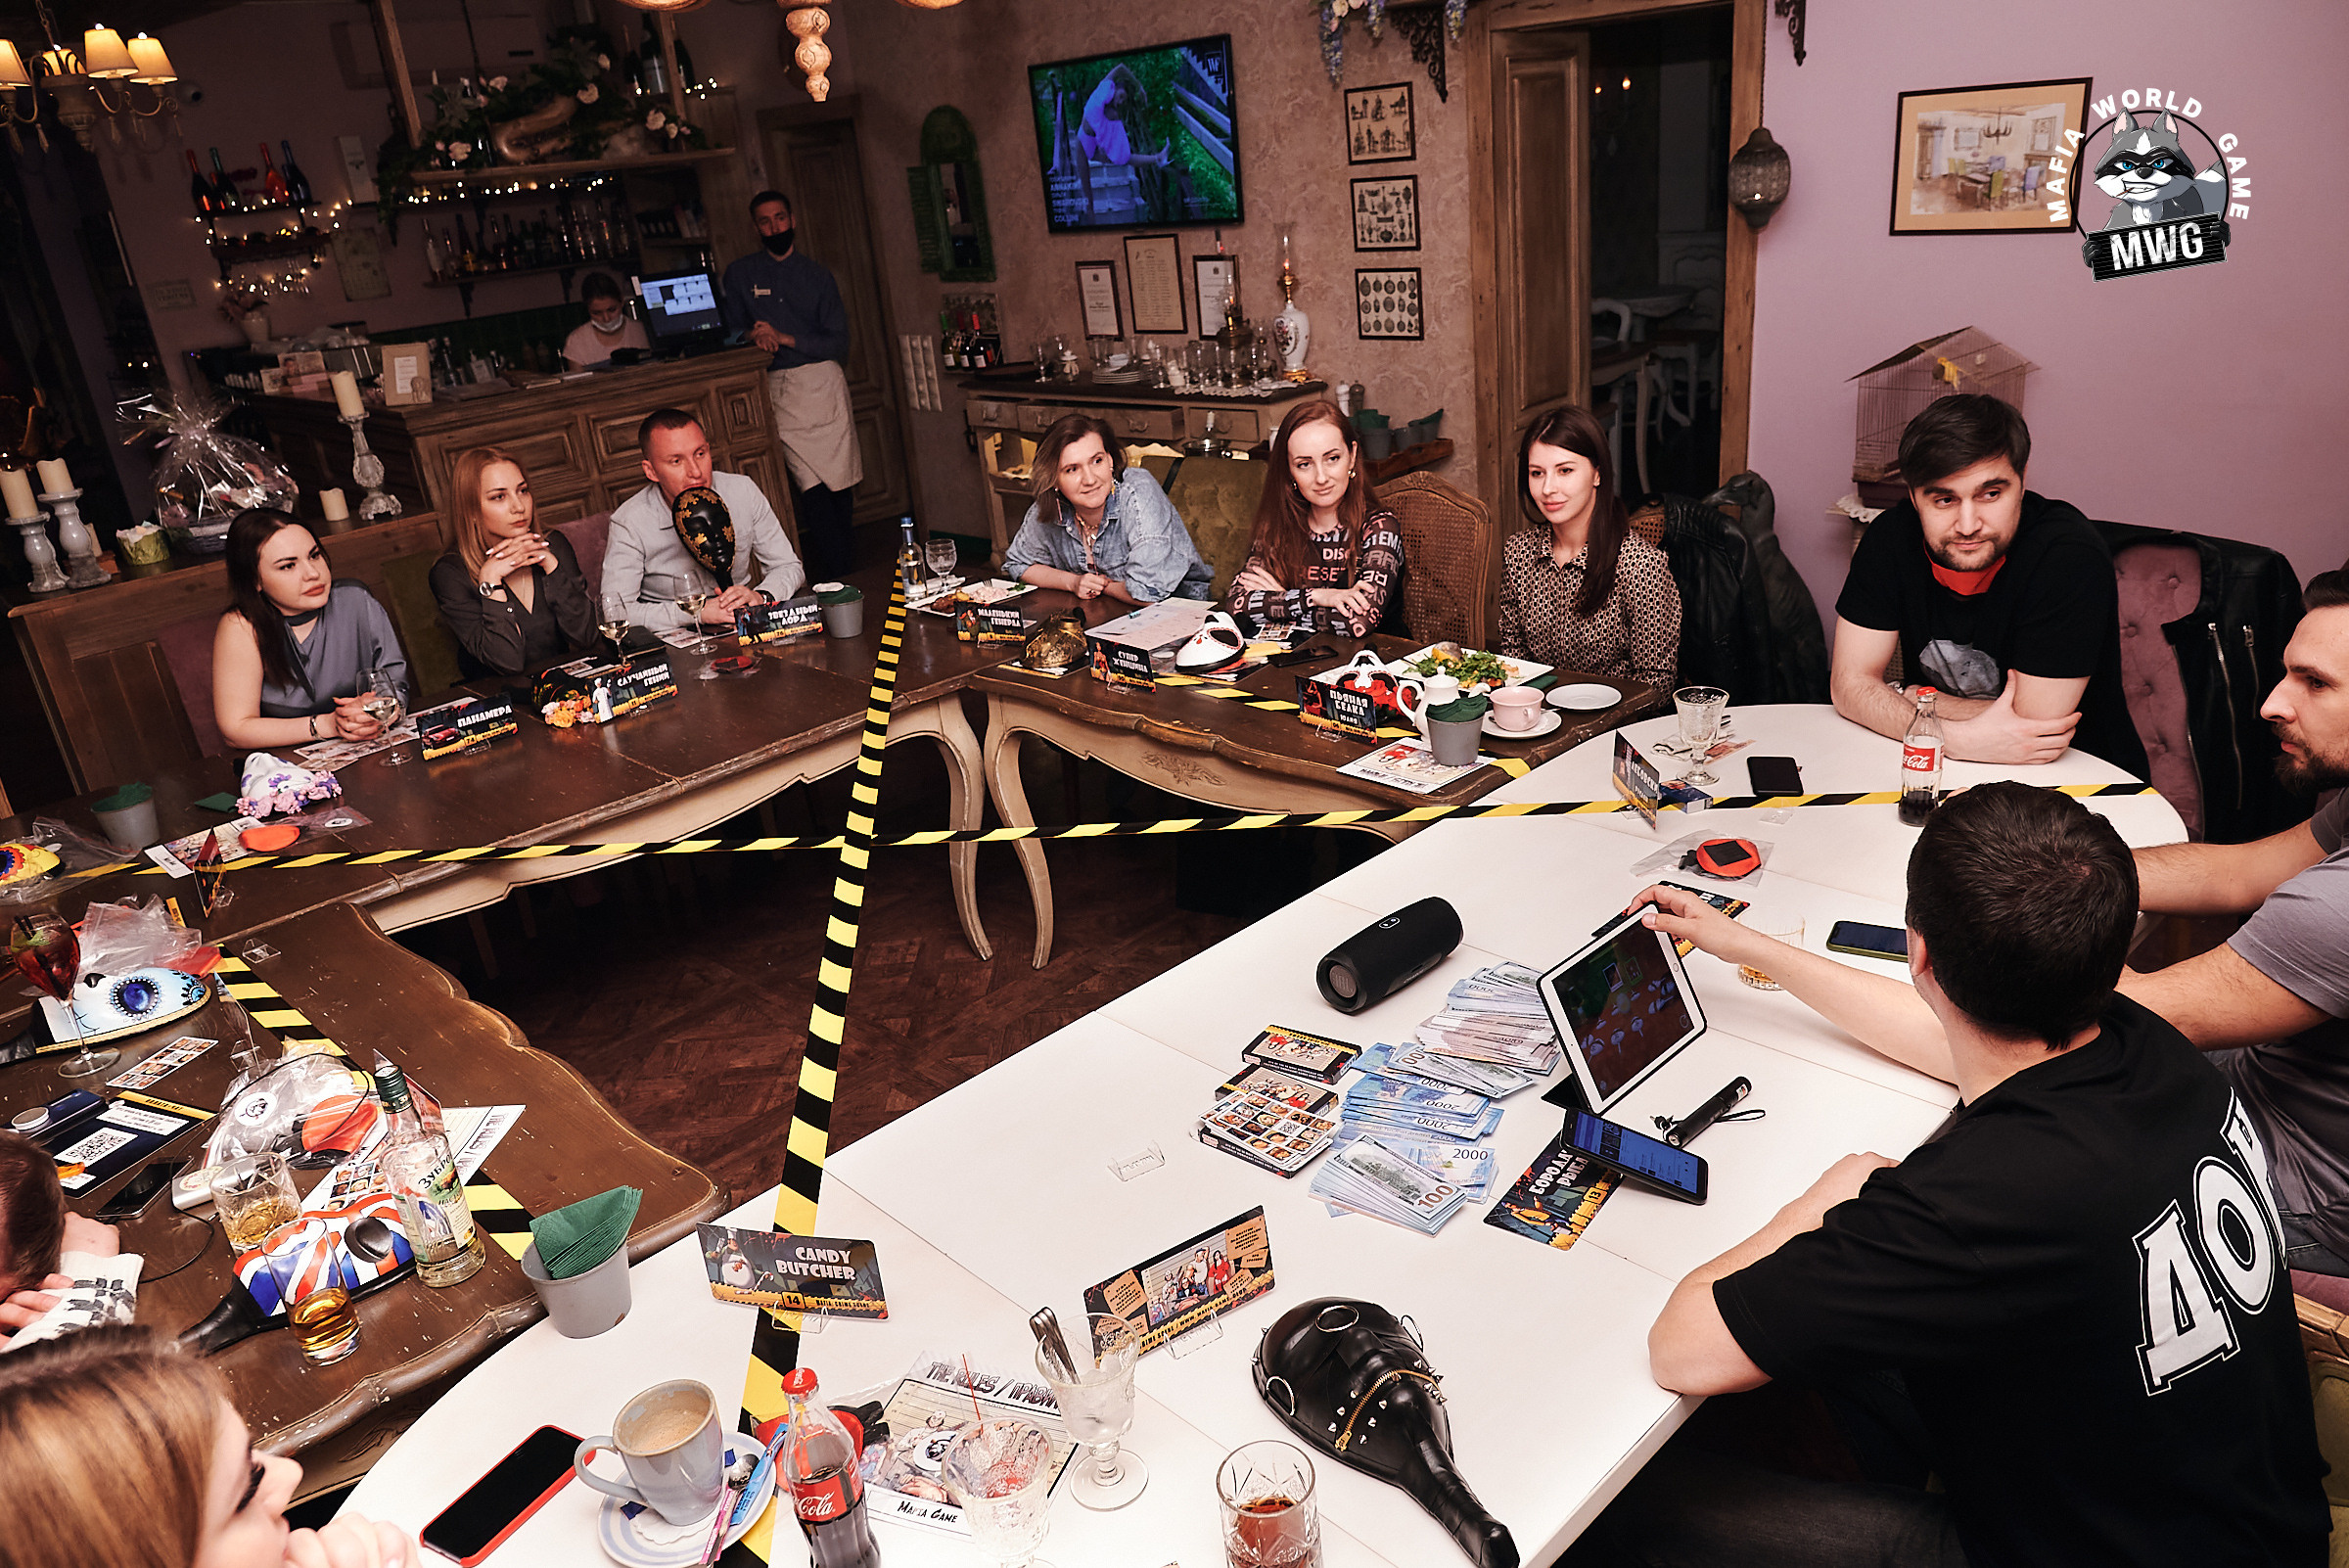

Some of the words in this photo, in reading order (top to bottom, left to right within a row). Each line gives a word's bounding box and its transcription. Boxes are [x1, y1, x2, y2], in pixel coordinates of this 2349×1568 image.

[1329, 689, 1368, 709] ПЬЯНАЯ
[1334, 700, 1365, 716] БЕЛКА
[457, 705, 513, 728] ПАНАМЕРА
[1451, 1148, 1489, 1161] 2000
[1528, 1149, 1574, 1195] БОРОДА
[1417, 1184, 1454, 1209] 100
[1588, 1191, 1602, 1200] 13
[795, 1246, 852, 1265] CANDY
[775, 1259, 856, 1281] BUTCHER
[786, 1295, 801, 1306] 14
[926, 1360, 957, 1383] THE
